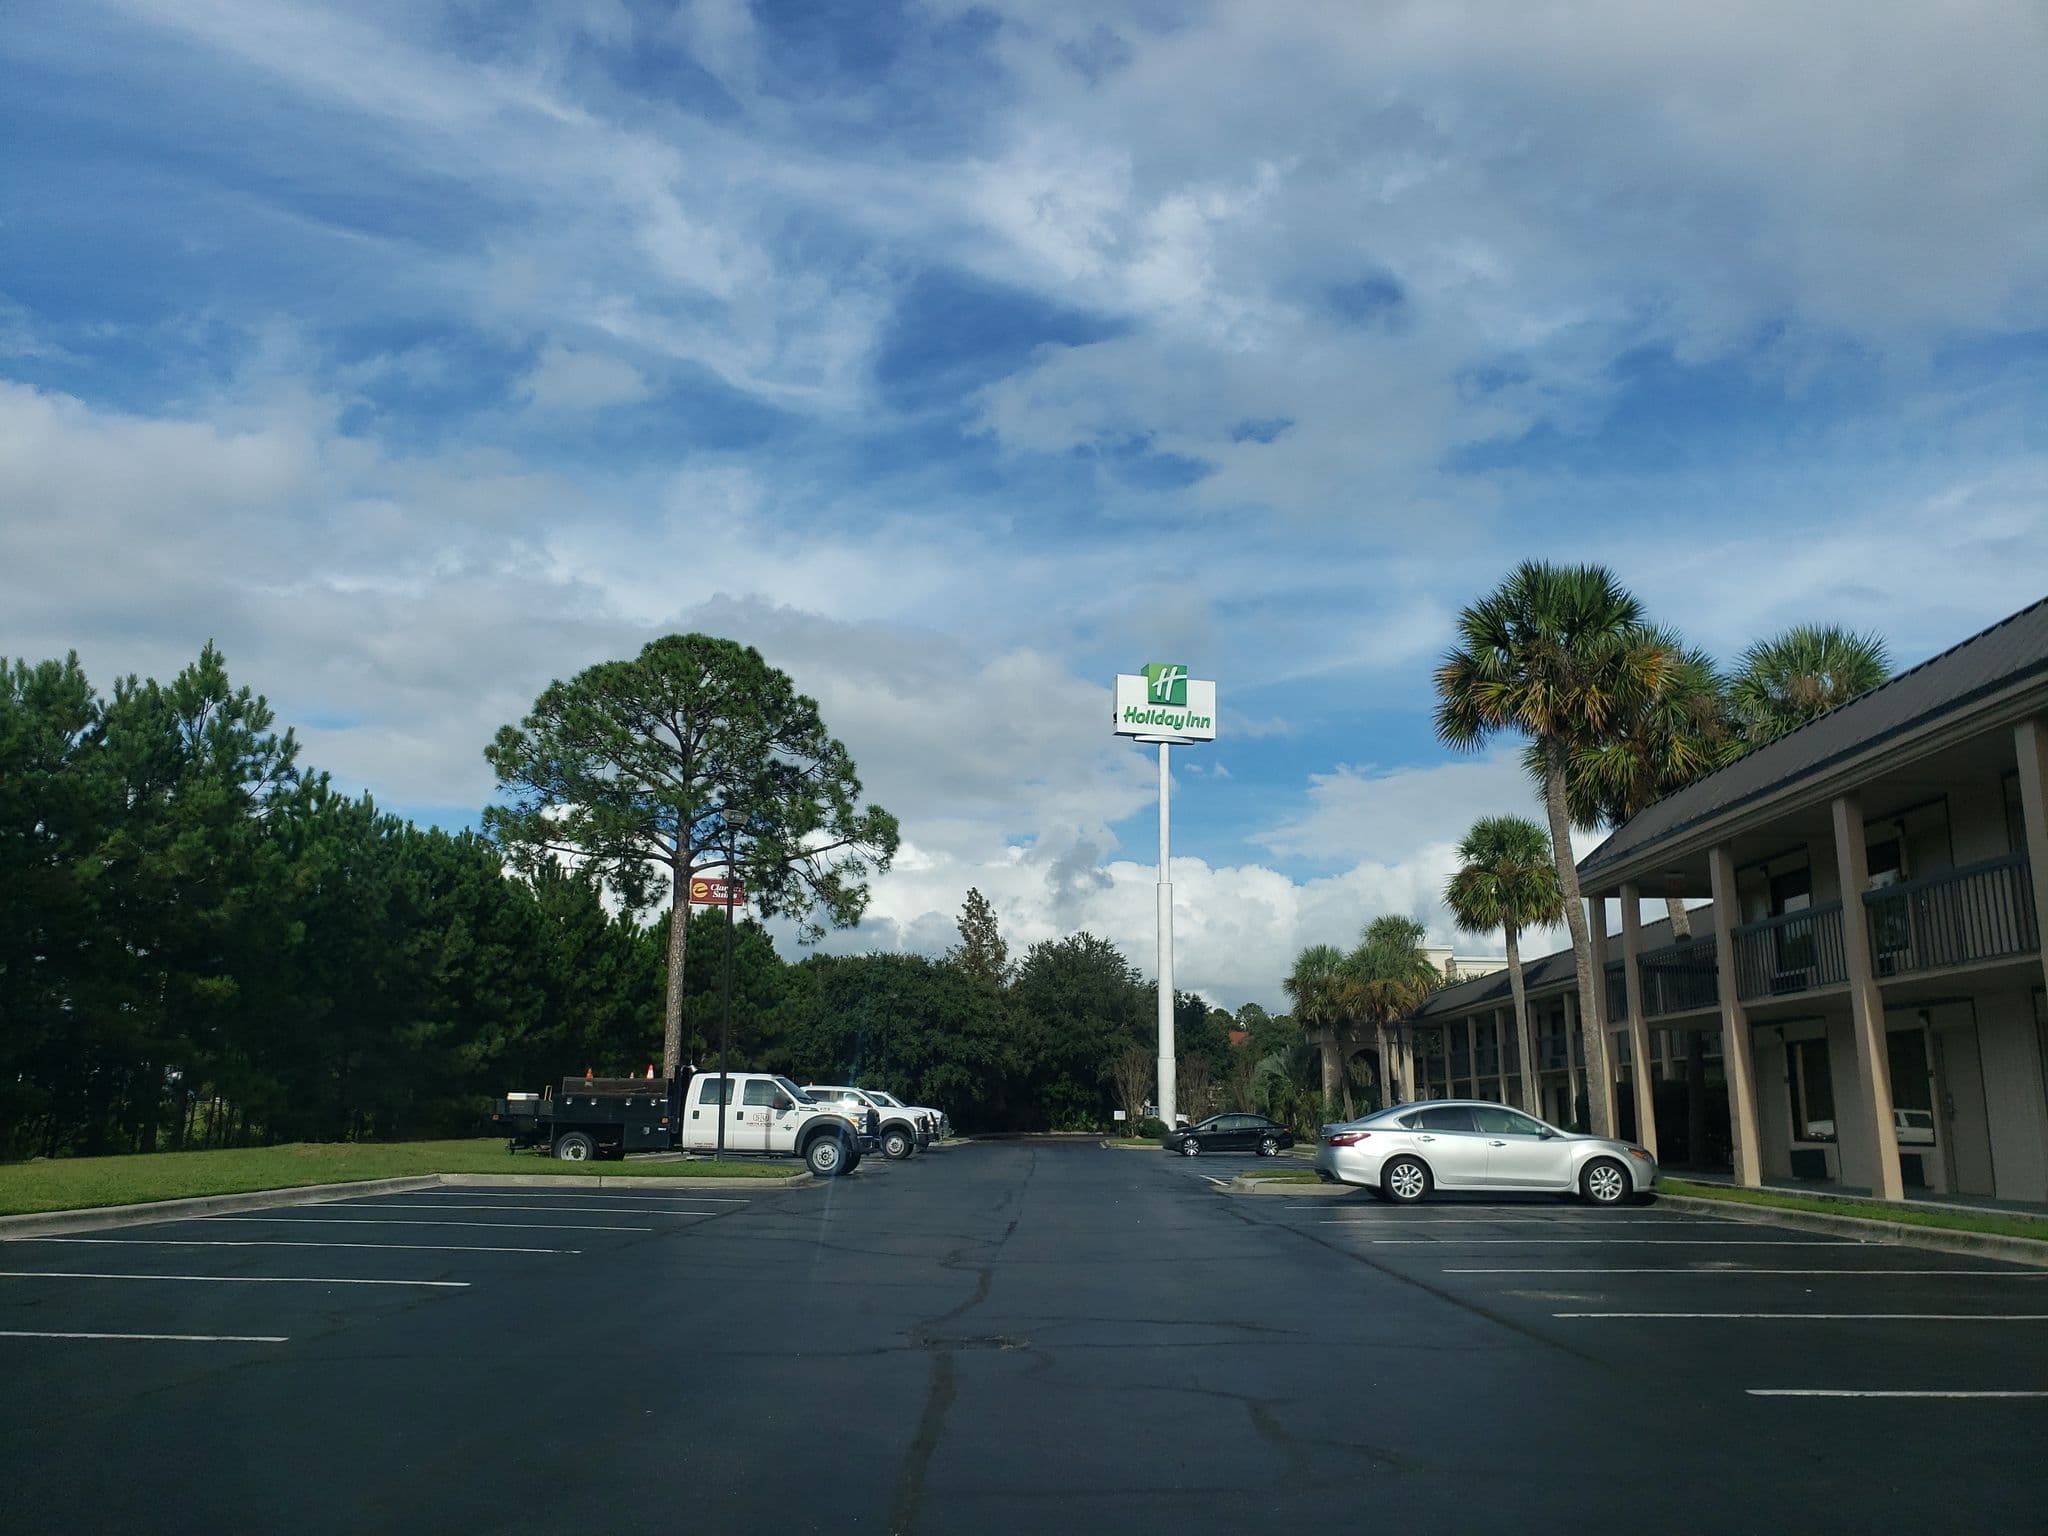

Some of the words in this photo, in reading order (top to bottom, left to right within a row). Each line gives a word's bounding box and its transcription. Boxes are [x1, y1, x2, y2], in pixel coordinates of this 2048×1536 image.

[1123, 705, 1185, 731] Holiday
[1186, 710, 1211, 729] Inn
[710, 883, 742, 892] Clar
[712, 891, 738, 899] Suits
